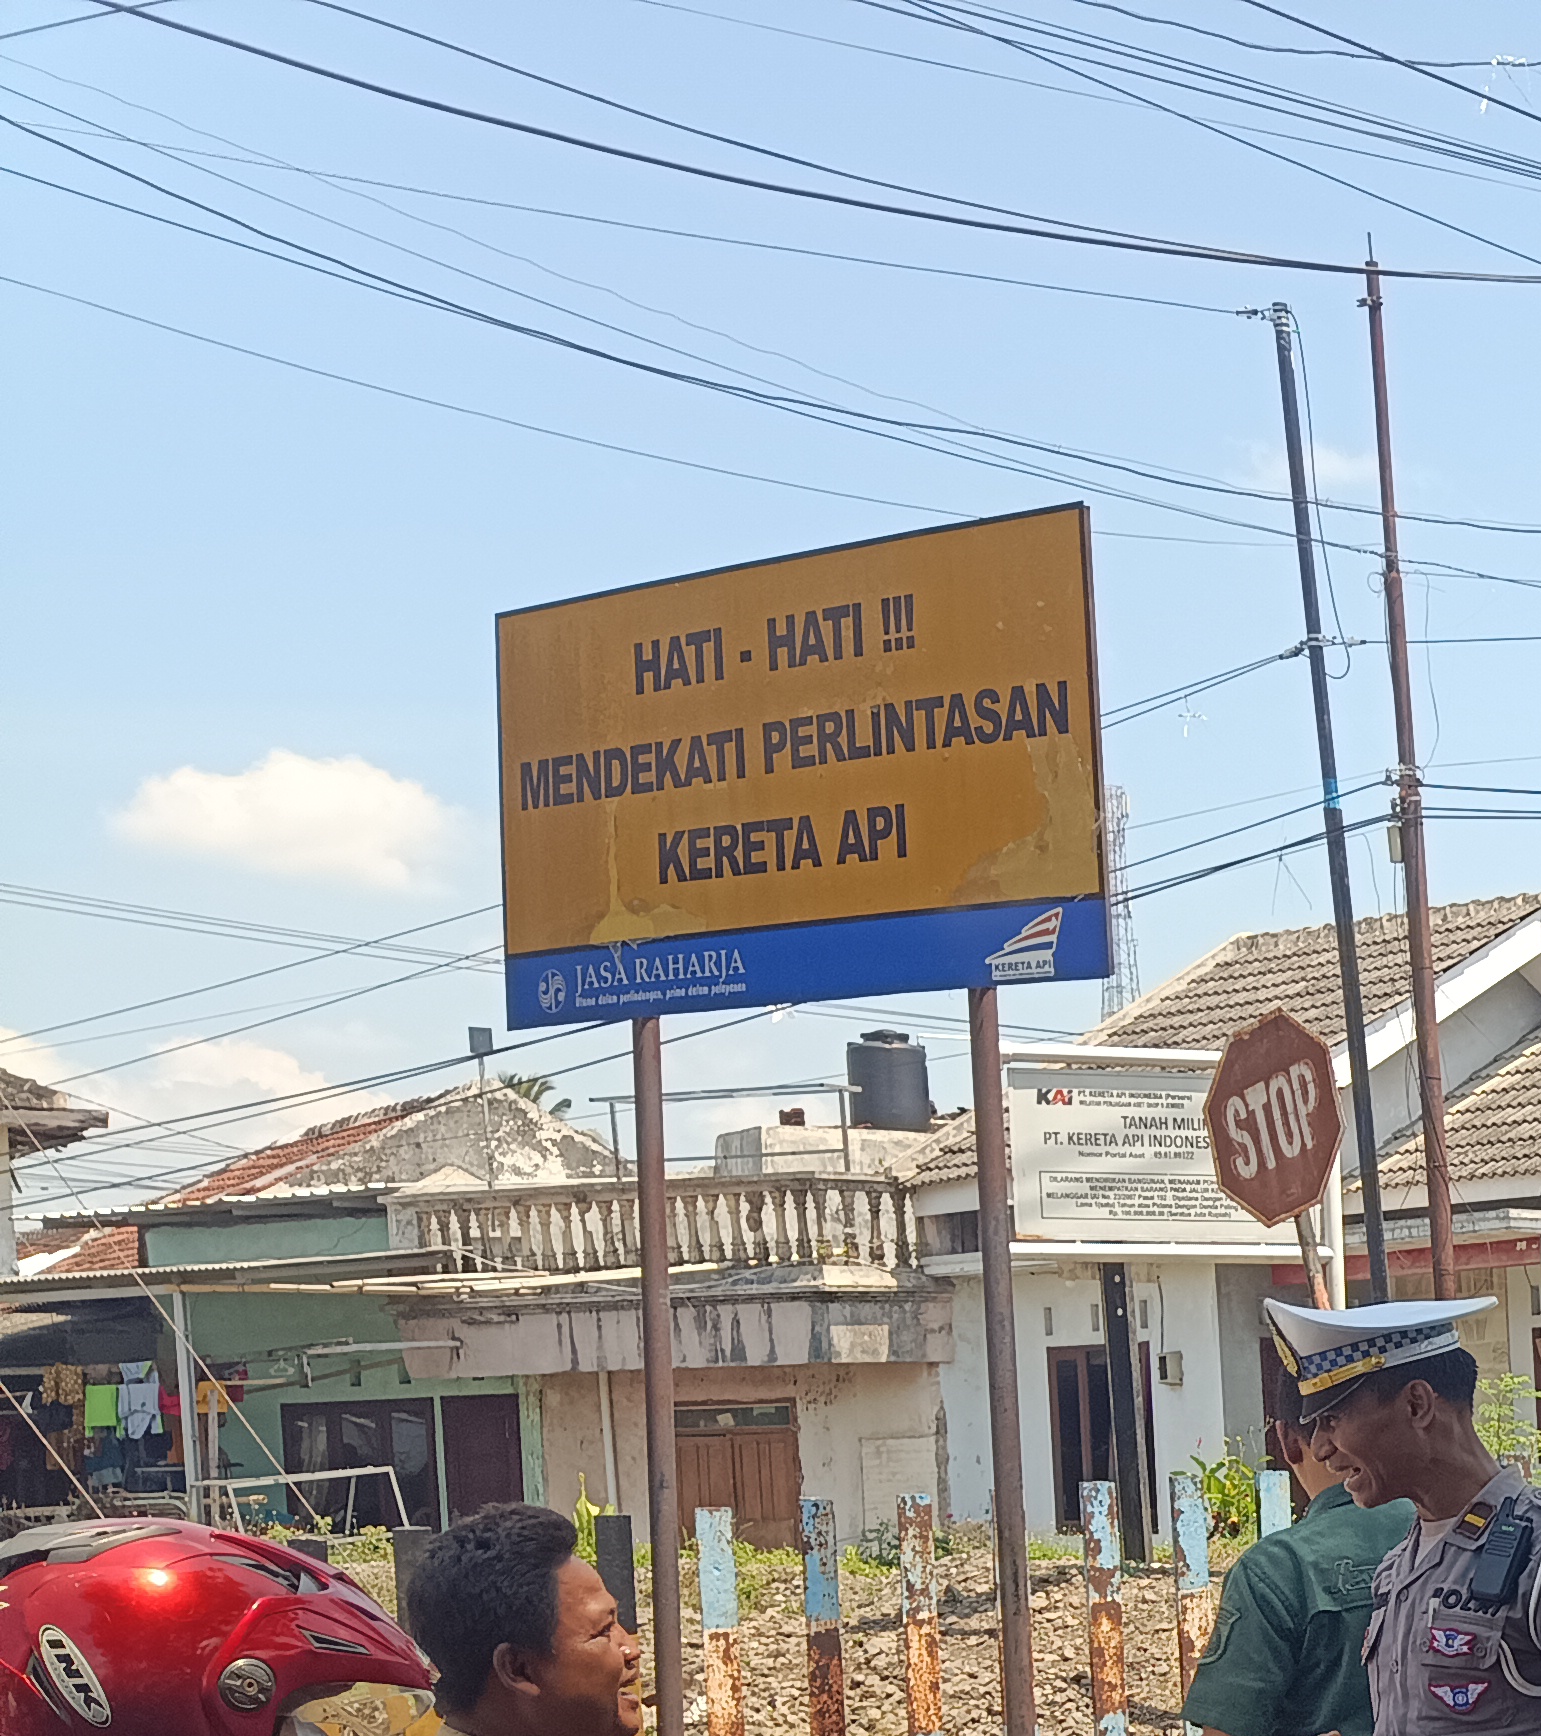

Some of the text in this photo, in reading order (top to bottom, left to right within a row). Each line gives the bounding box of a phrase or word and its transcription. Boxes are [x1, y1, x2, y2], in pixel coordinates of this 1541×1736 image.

[633, 626, 725, 696] HATI
[766, 602, 864, 672] HATI
[880, 592, 916, 654] !!!
[520, 680, 1070, 811] MENDEKATI PERLINTASAN
[657, 803, 908, 885] KERETA API
[575, 948, 746, 996] JASA RAHARJA
[994, 959, 1052, 972] KERETA API
[1043, 1132, 1209, 1150] PT. KERETA API INDONES
[1121, 1115, 1168, 1130] TANAH
[1226, 1060, 1318, 1180] STOP
[45, 1638, 107, 1714] INK
